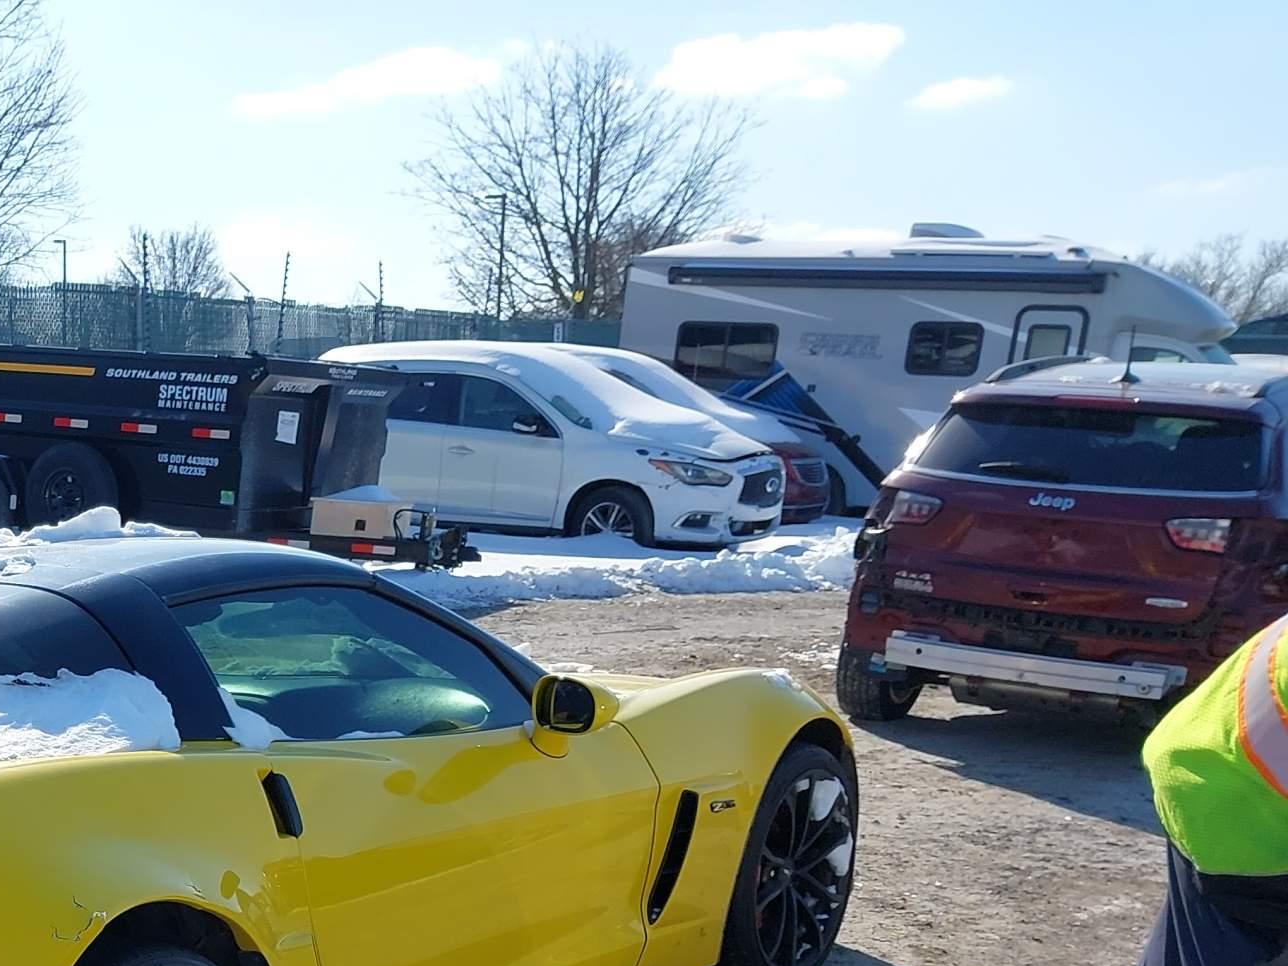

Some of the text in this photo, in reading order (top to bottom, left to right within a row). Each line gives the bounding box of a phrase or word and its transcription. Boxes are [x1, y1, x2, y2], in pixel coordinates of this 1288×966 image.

[105, 368, 239, 385] SOUTHLAND TRAILERS
[158, 384, 228, 402] SPECTRUM
[271, 381, 320, 394] SPECTRUM
[346, 388, 389, 398] MAINTENANCE
[157, 399, 227, 412] MAINTENANCE
[158, 453, 169, 463] US
[170, 454, 186, 464] DOT
[167, 464, 178, 474] PA
[1028, 492, 1076, 511] Jeep
